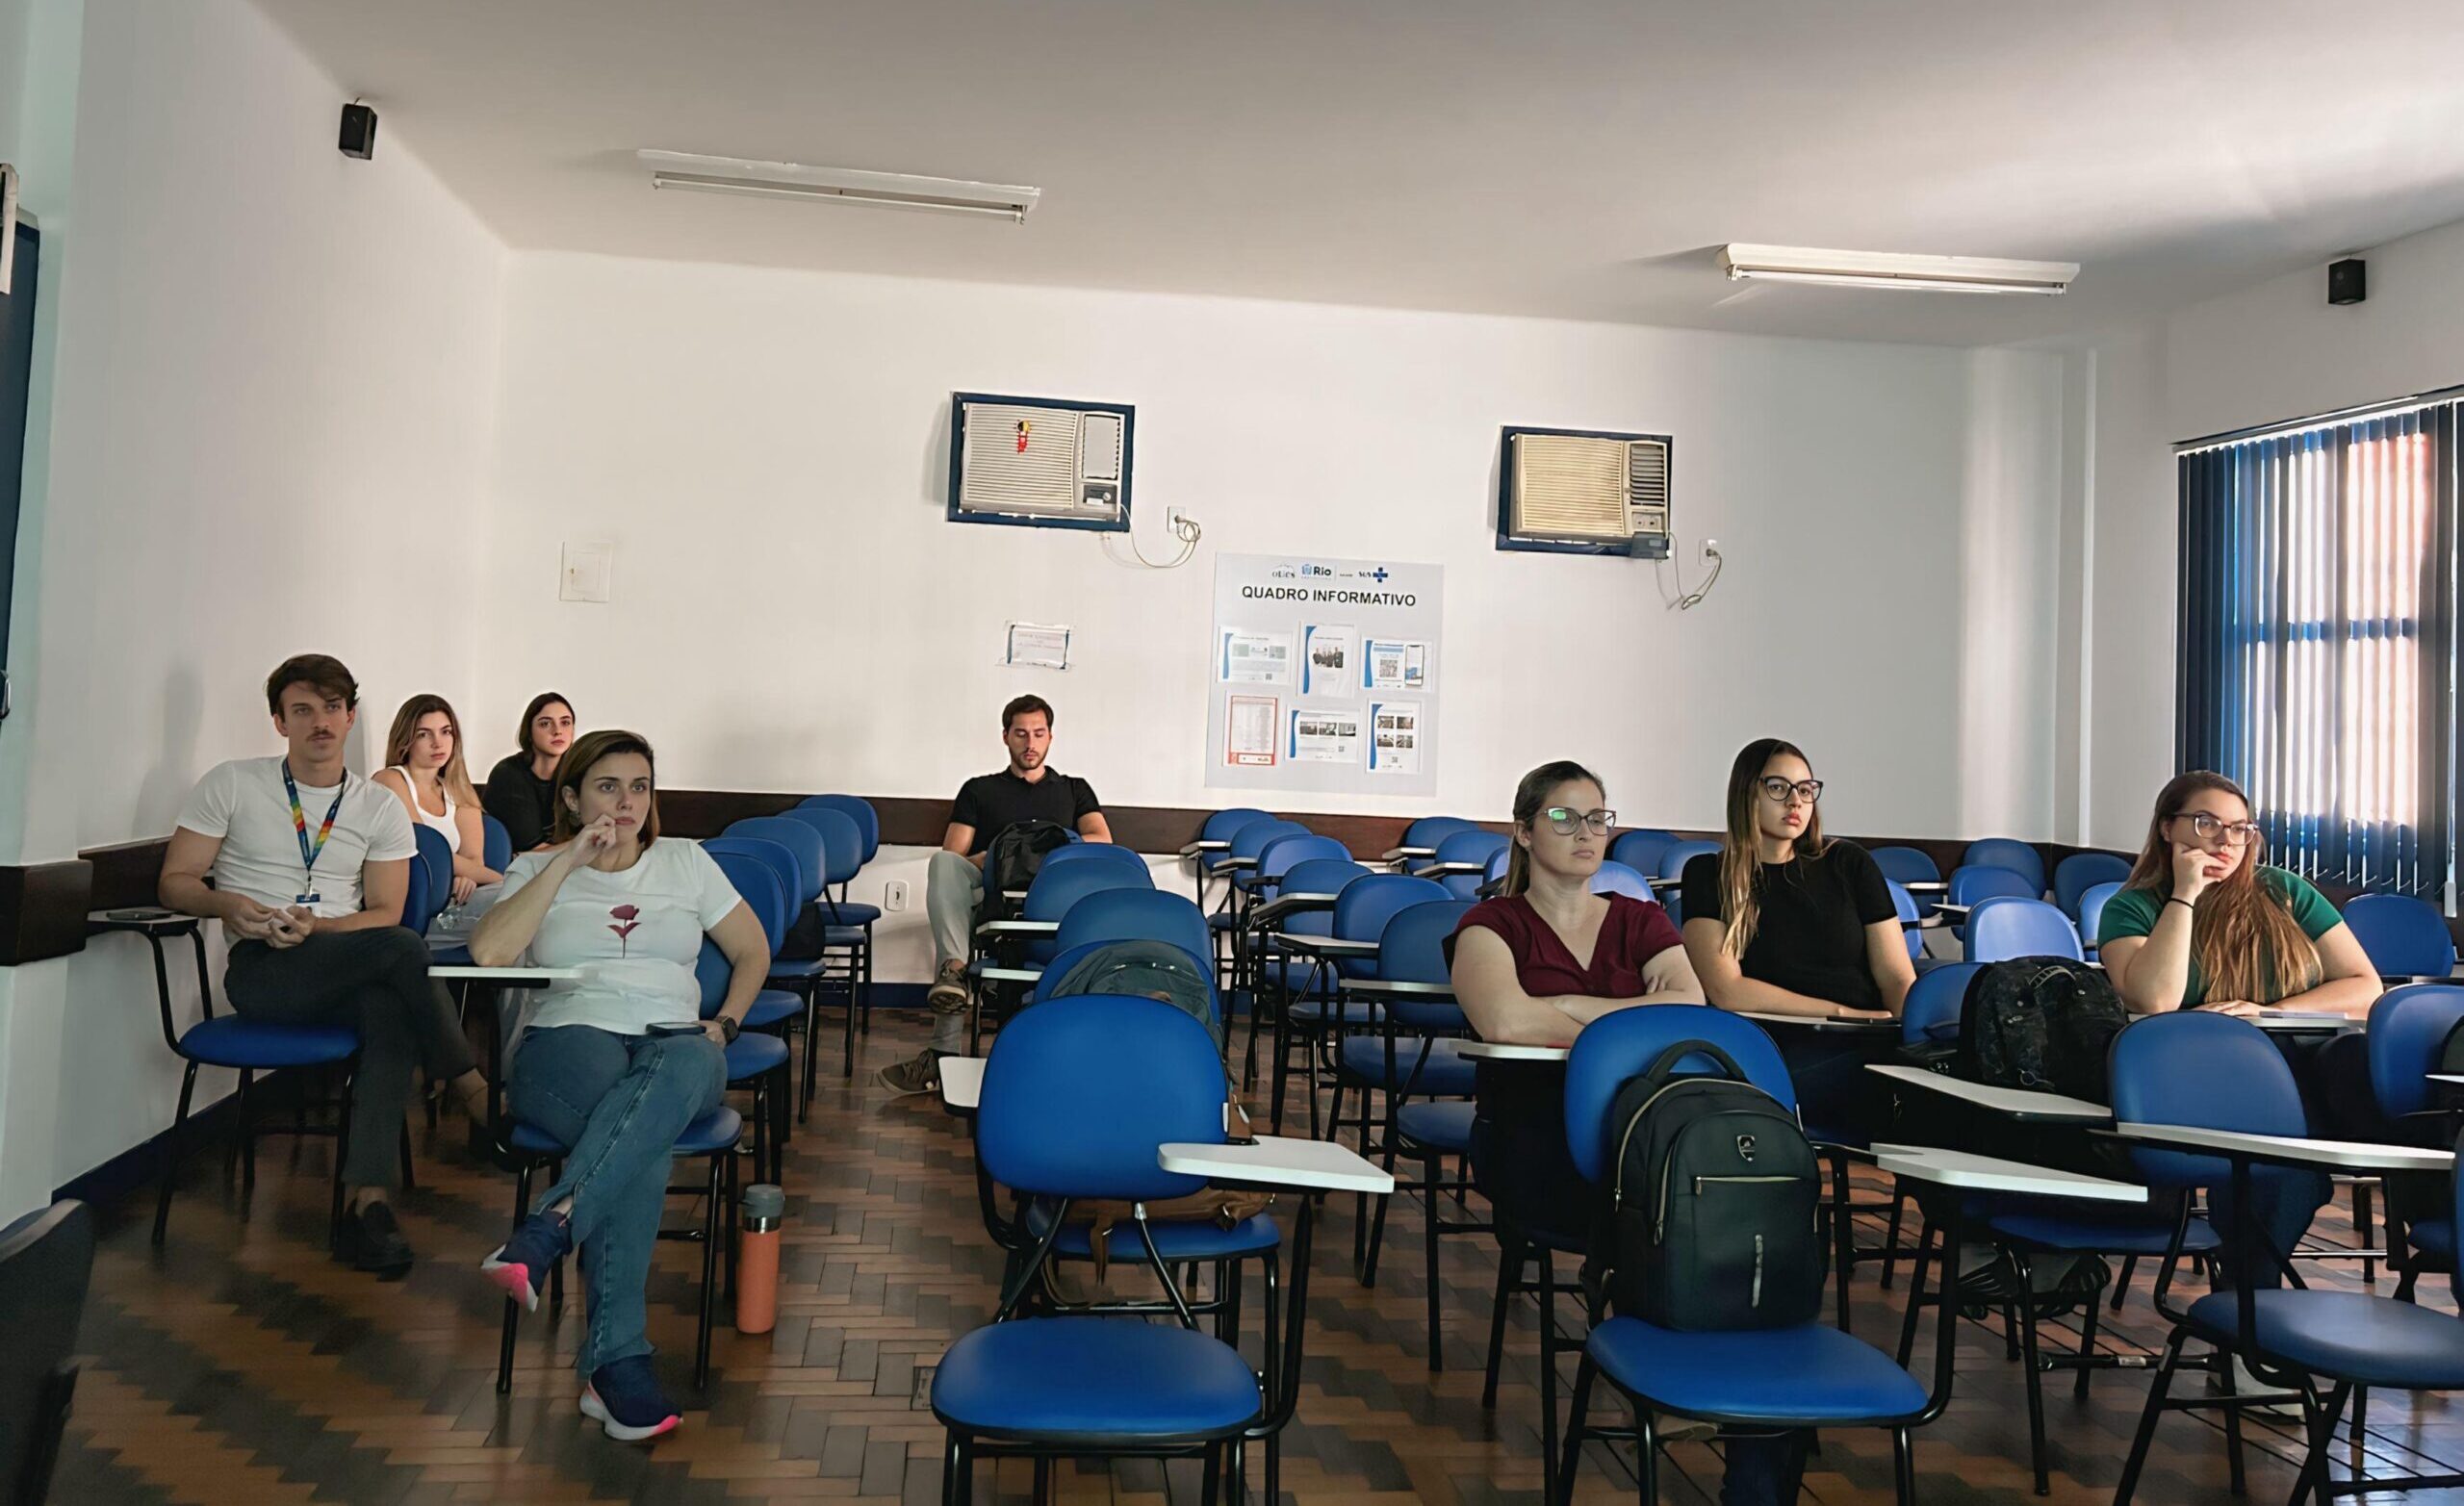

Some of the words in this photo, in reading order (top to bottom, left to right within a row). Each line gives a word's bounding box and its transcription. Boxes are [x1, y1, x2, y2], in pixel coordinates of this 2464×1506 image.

[1313, 566, 1332, 576] Rio
[1242, 586, 1309, 601] QUADRO
[1313, 589, 1416, 606] INFORMATIVO
